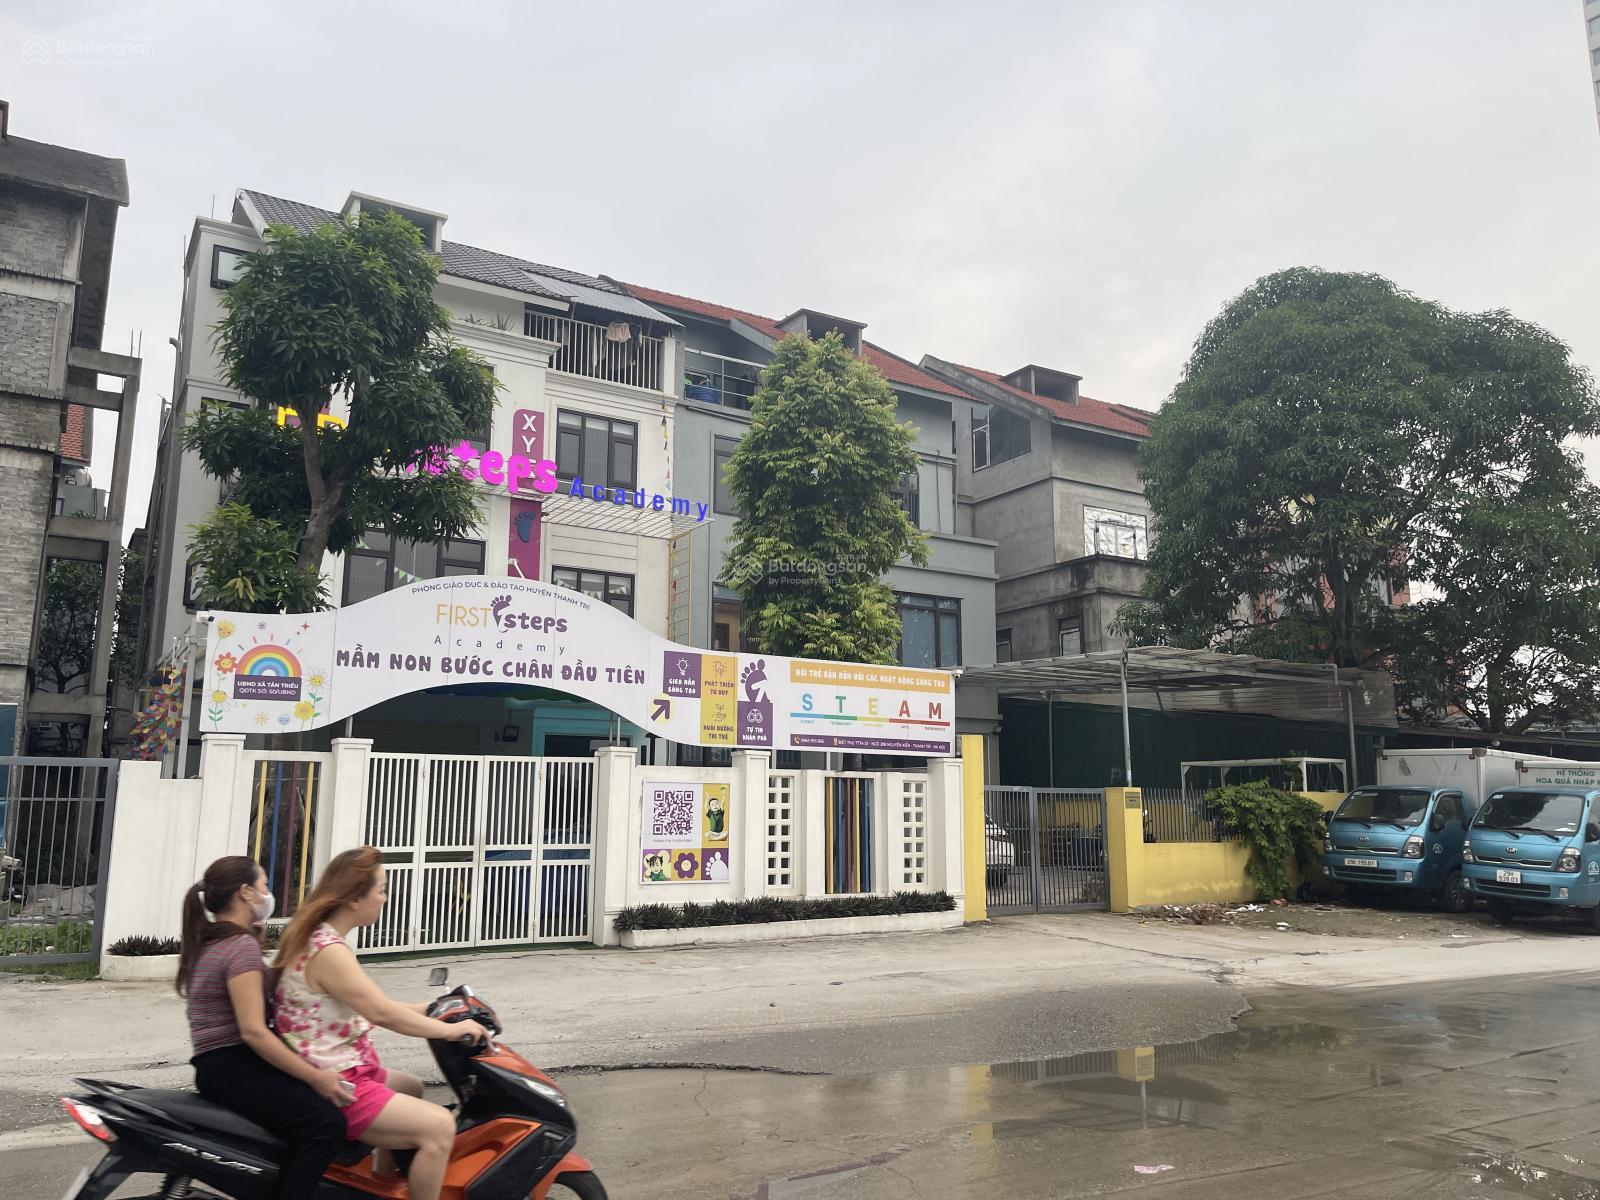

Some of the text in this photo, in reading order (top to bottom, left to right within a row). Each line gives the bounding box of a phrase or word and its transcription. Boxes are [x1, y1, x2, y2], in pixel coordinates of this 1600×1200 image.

[569, 475, 709, 523] Academy
[436, 603, 568, 634] FIRST steps
[434, 634, 565, 656] Academy
[336, 643, 645, 685] MẦM NON BƯỚC CHÂN ĐẦU TIÊN
